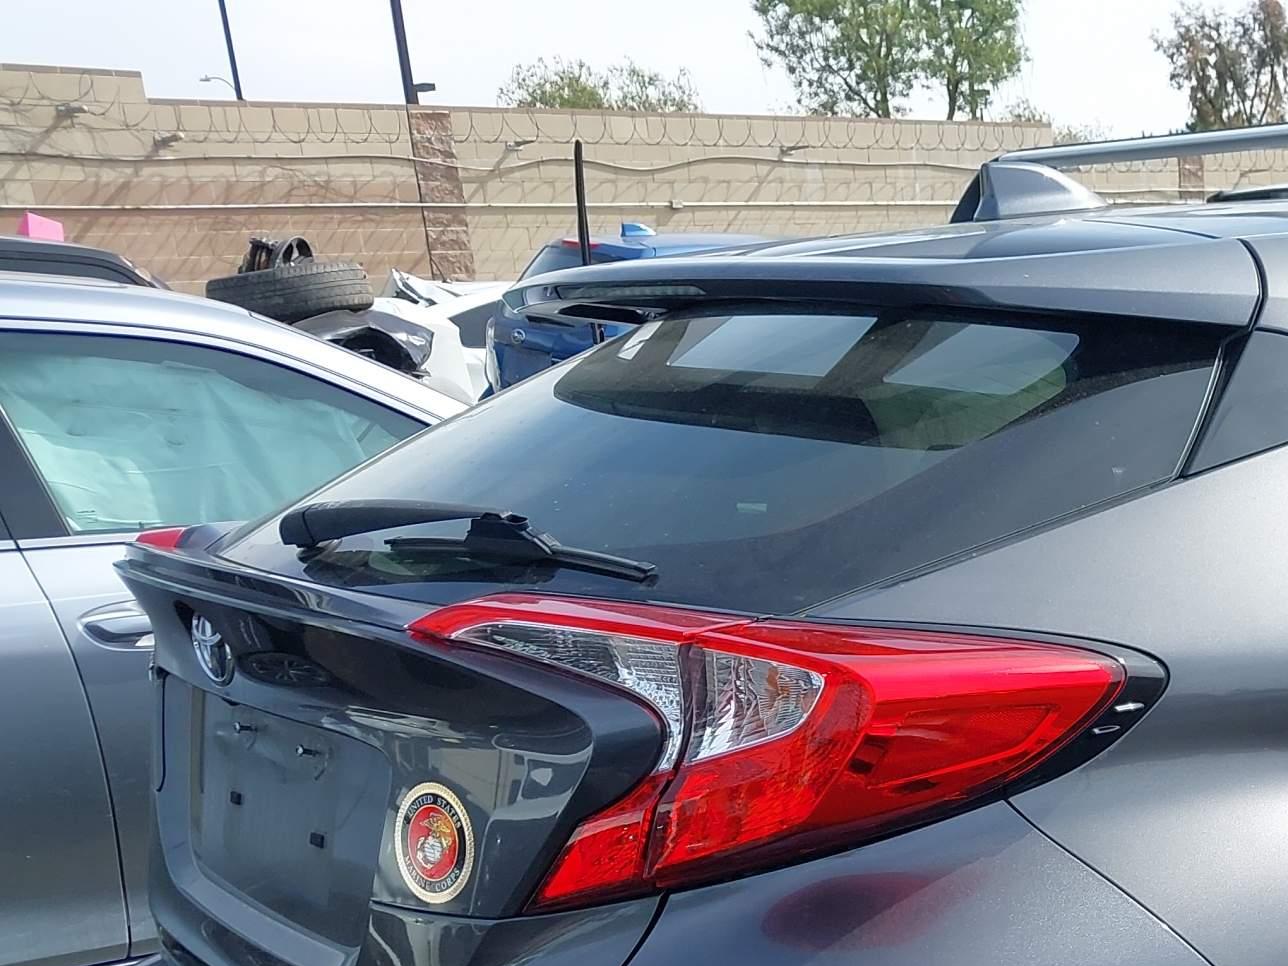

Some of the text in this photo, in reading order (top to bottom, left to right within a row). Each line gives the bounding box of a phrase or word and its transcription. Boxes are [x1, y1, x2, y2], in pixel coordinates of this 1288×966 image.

[407, 794, 462, 829] UNITED STATES
[405, 855, 461, 892] MARINE CORPS
